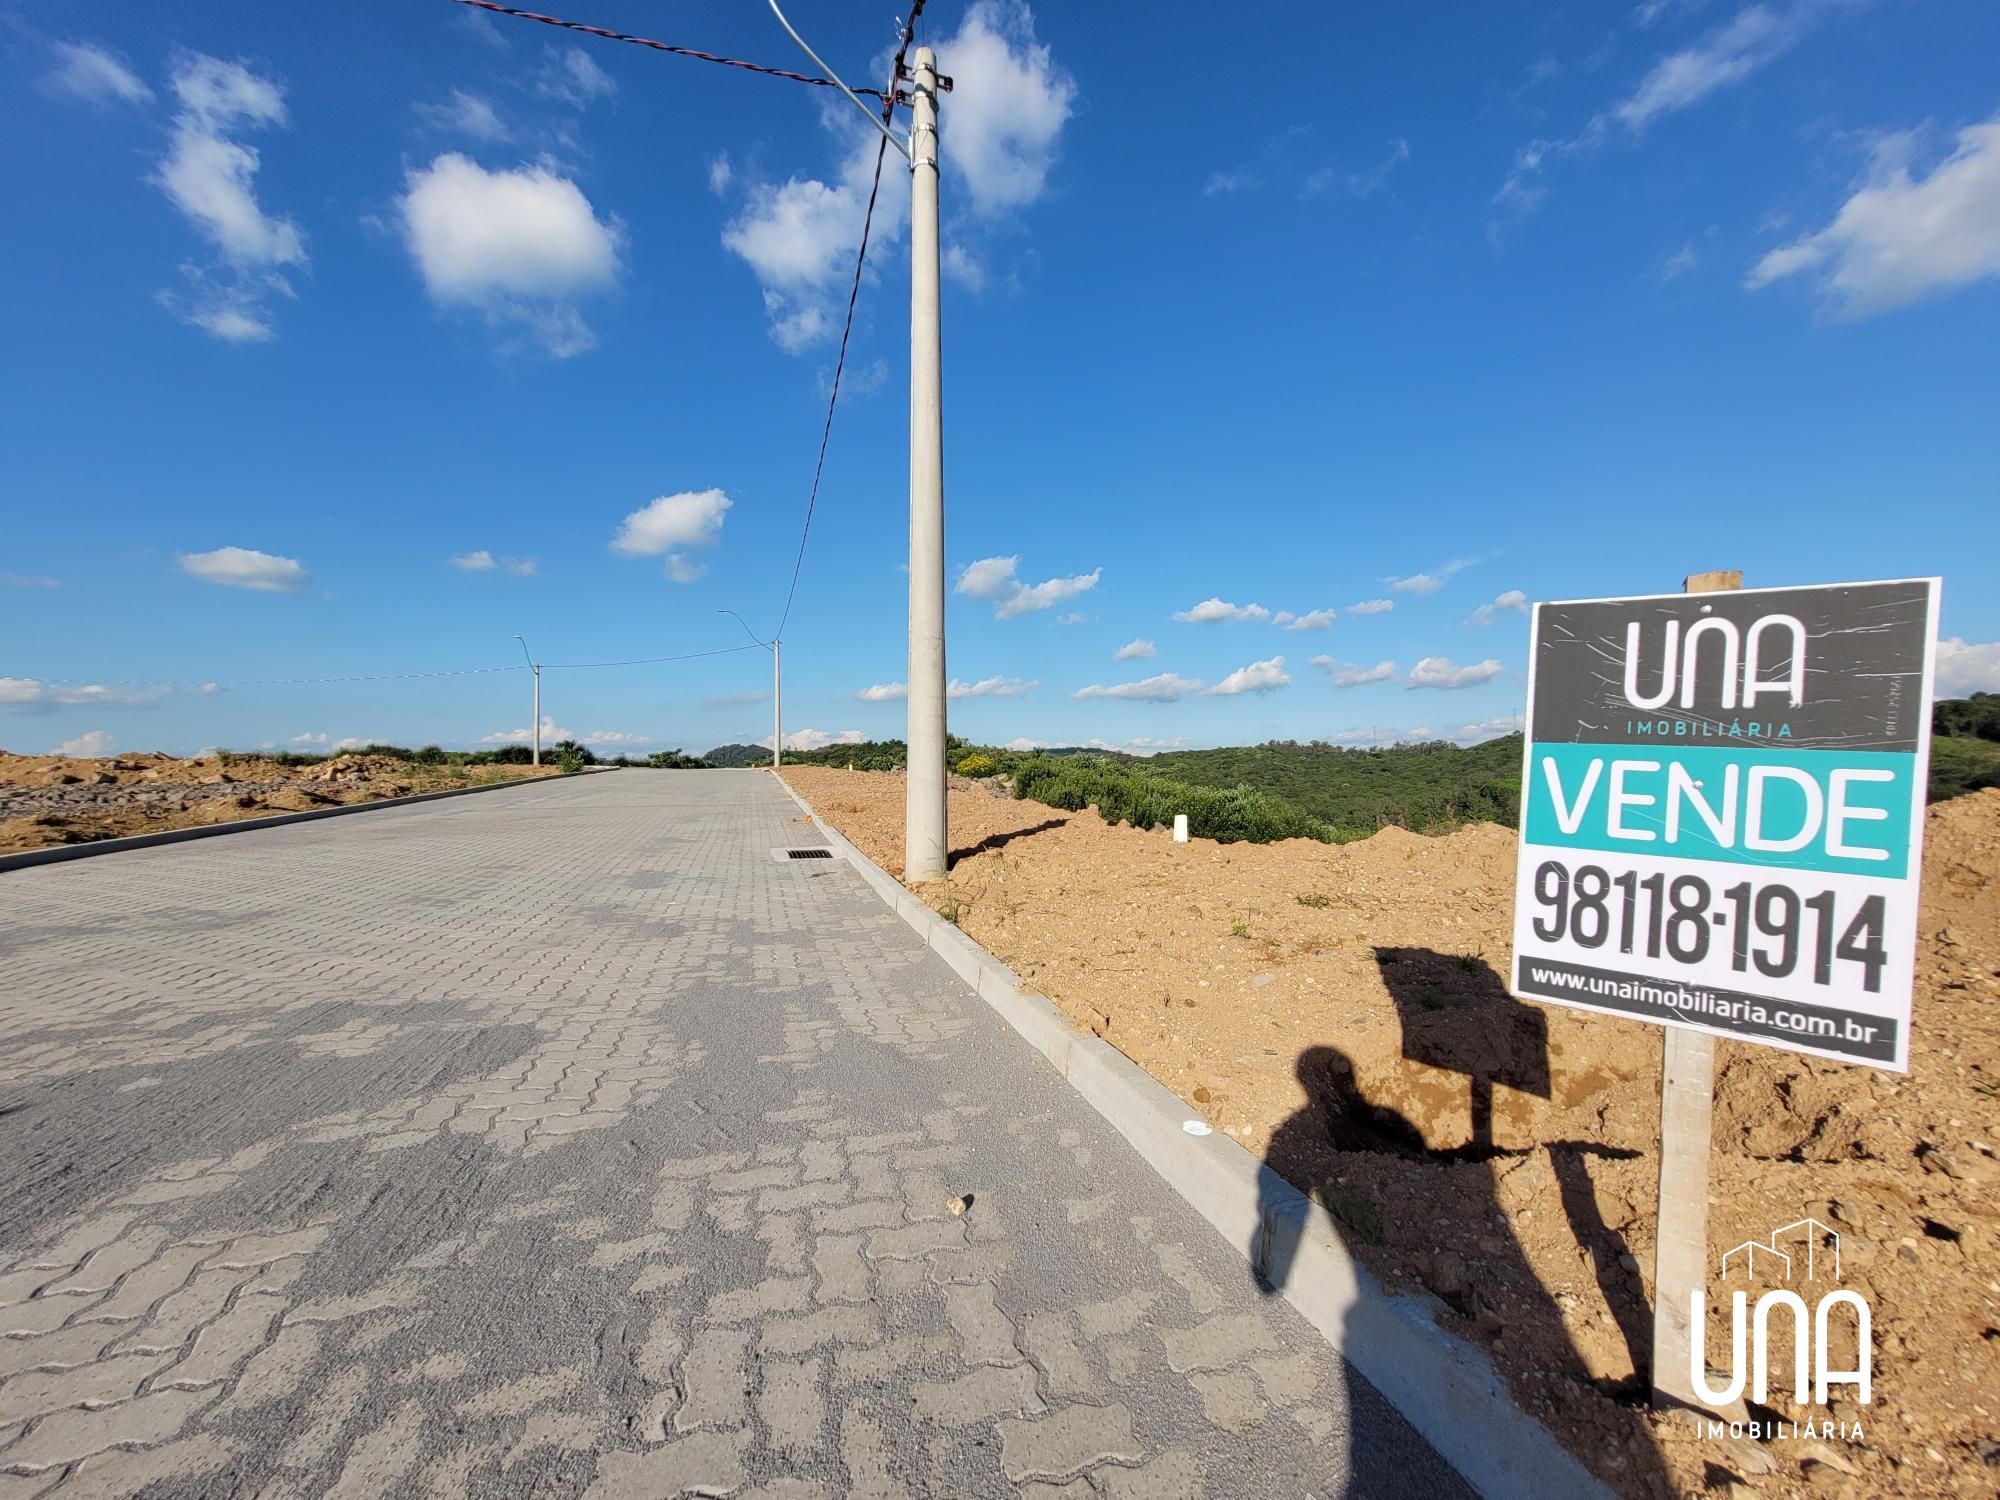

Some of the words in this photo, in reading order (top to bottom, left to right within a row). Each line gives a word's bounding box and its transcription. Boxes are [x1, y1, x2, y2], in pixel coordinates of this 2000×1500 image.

[1624, 614, 1806, 709] UNA
[1627, 718, 1793, 738] IMOBILIÁRIA
[1542, 757, 1896, 861] VENDE
[1532, 860, 1887, 993] 98118-1914
[1532, 967, 1878, 1044] www.unaimobiliaria.com.br
